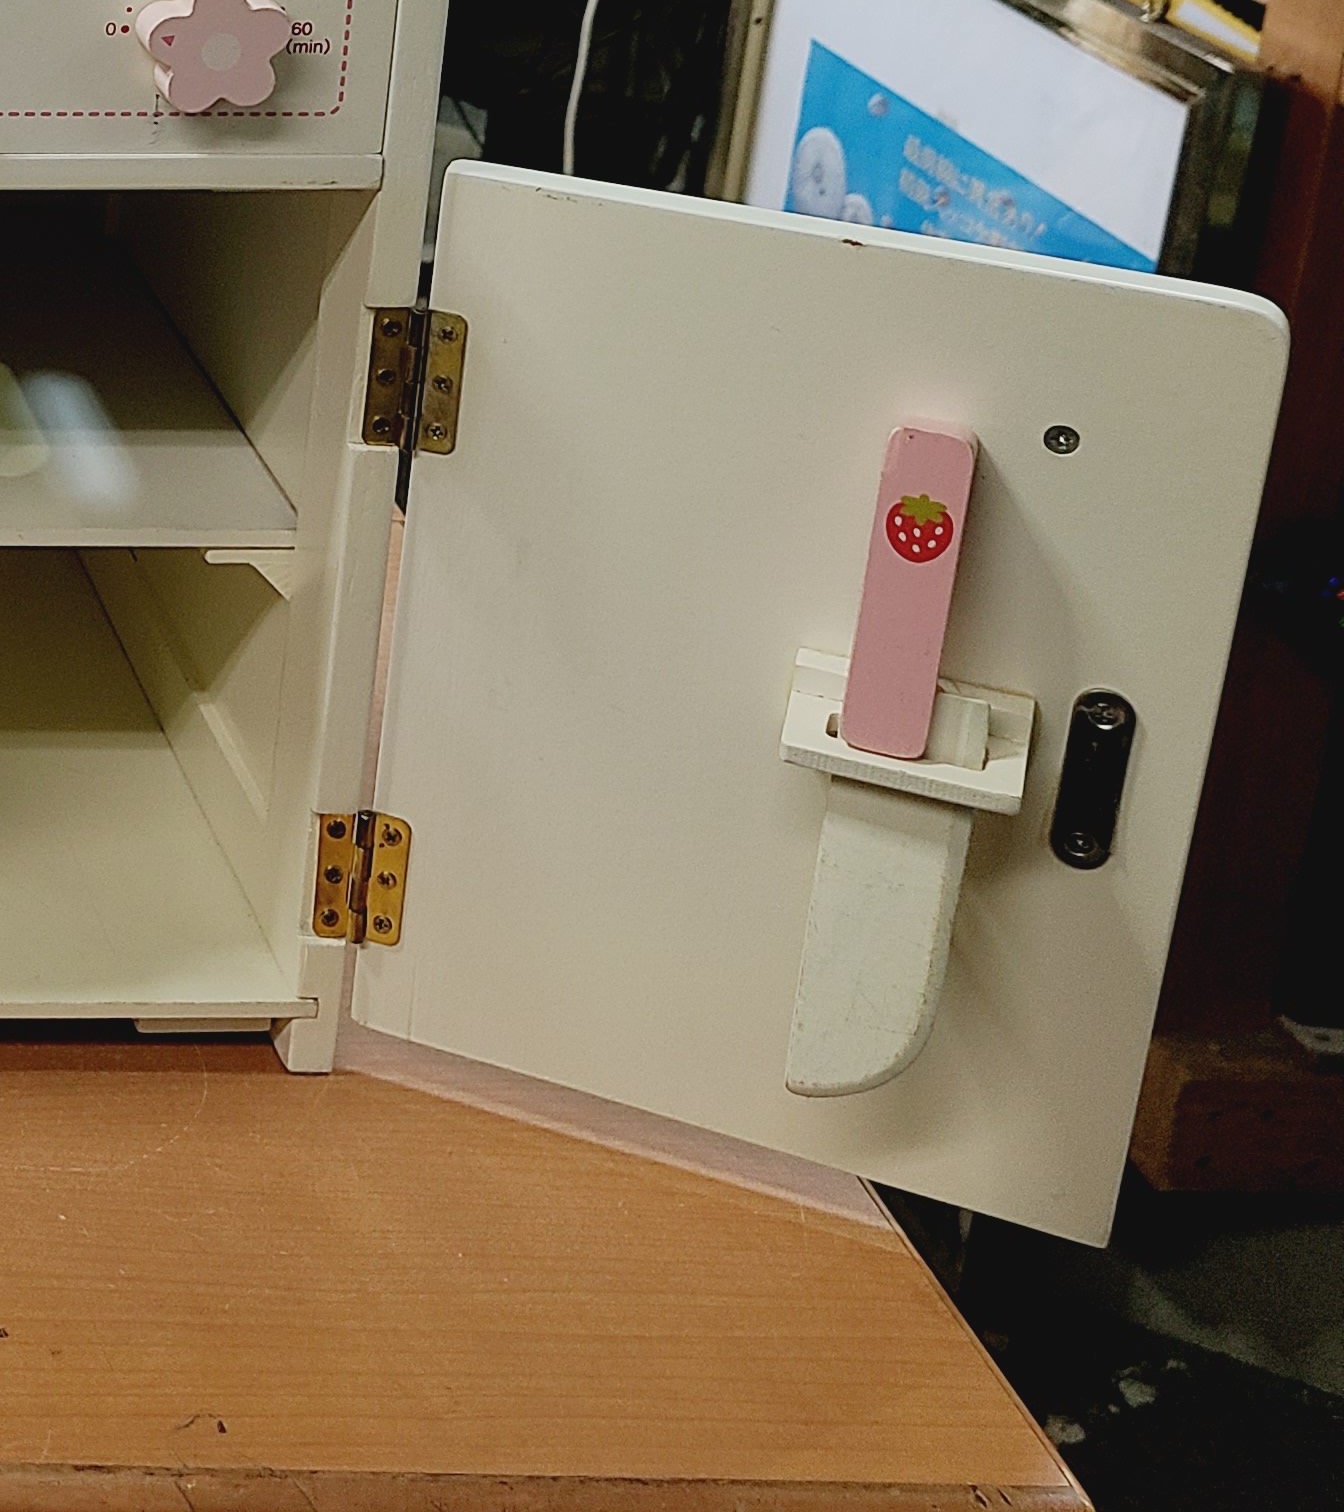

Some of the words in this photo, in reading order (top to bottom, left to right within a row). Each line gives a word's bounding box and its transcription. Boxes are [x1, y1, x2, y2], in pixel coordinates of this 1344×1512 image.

[105, 22, 117, 36] 0
[291, 22, 313, 36] 60
[285, 39, 331, 56] (min)
